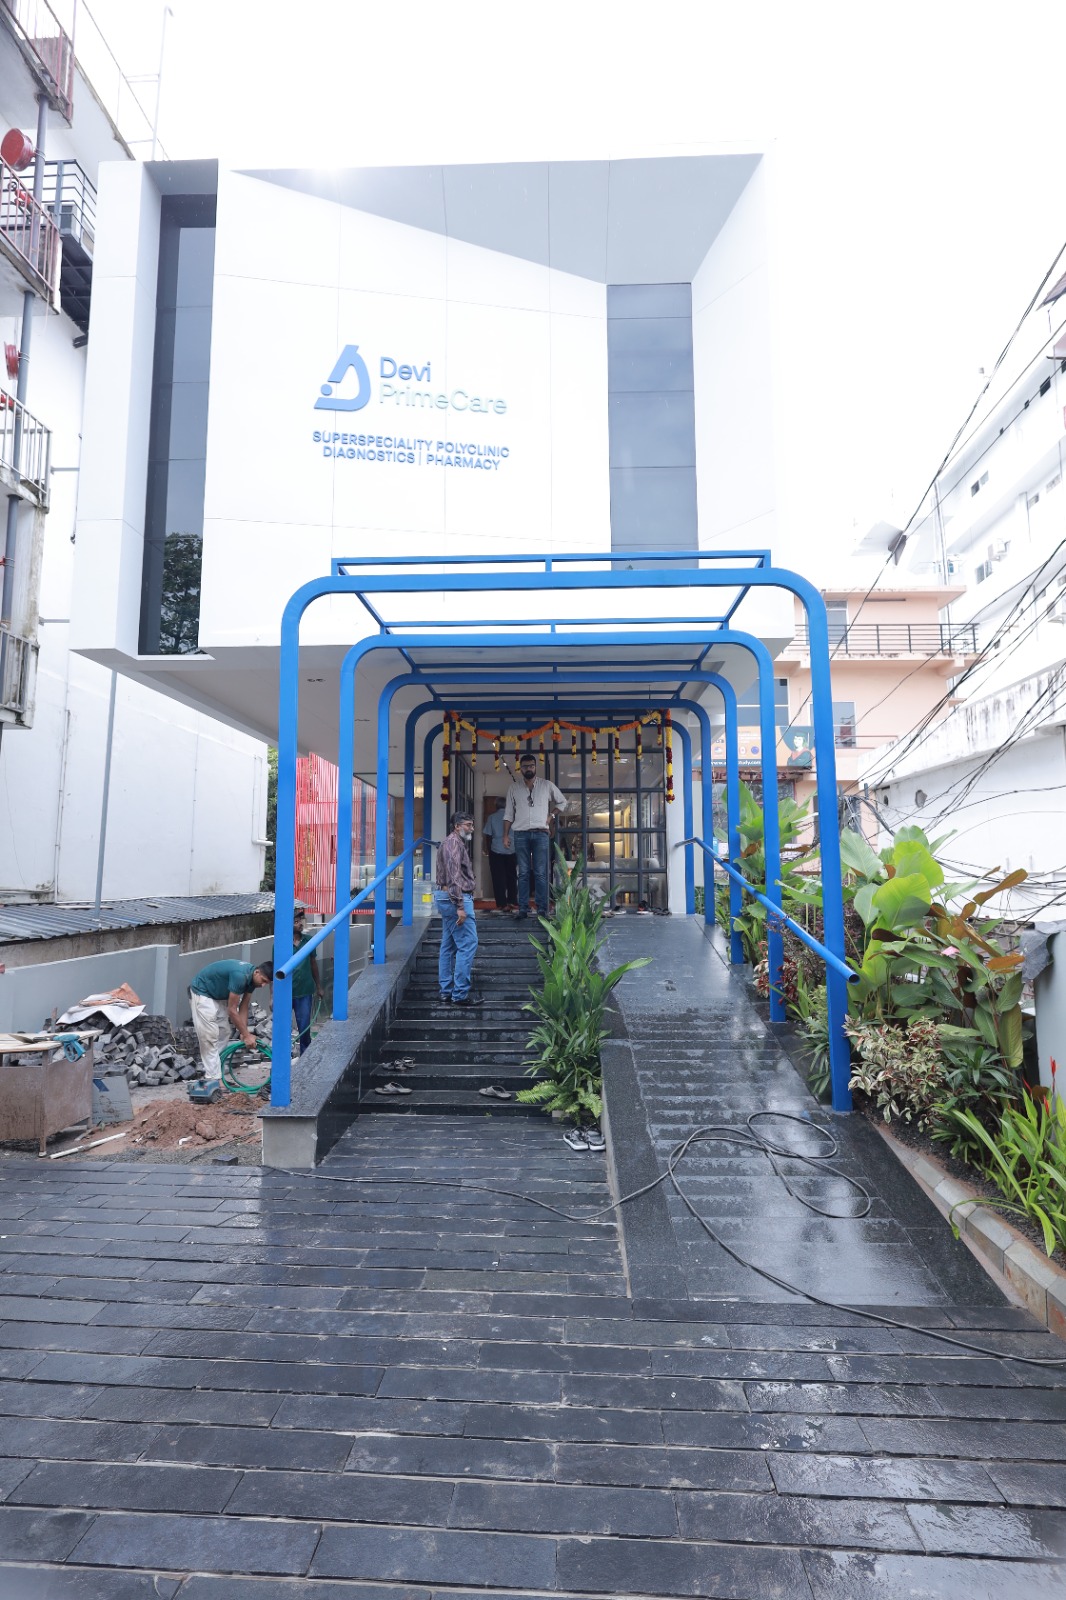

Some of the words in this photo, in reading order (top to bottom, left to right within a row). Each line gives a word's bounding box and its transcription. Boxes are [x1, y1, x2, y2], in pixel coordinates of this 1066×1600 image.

[380, 356, 431, 382] Devi
[379, 382, 507, 415] PrimeCare
[312, 430, 432, 451] SUPERSPECIALITY
[436, 440, 510, 458] POLYCLINIC
[323, 445, 415, 464] DIAGNOSTICS
[426, 453, 500, 471] PHARMACY
